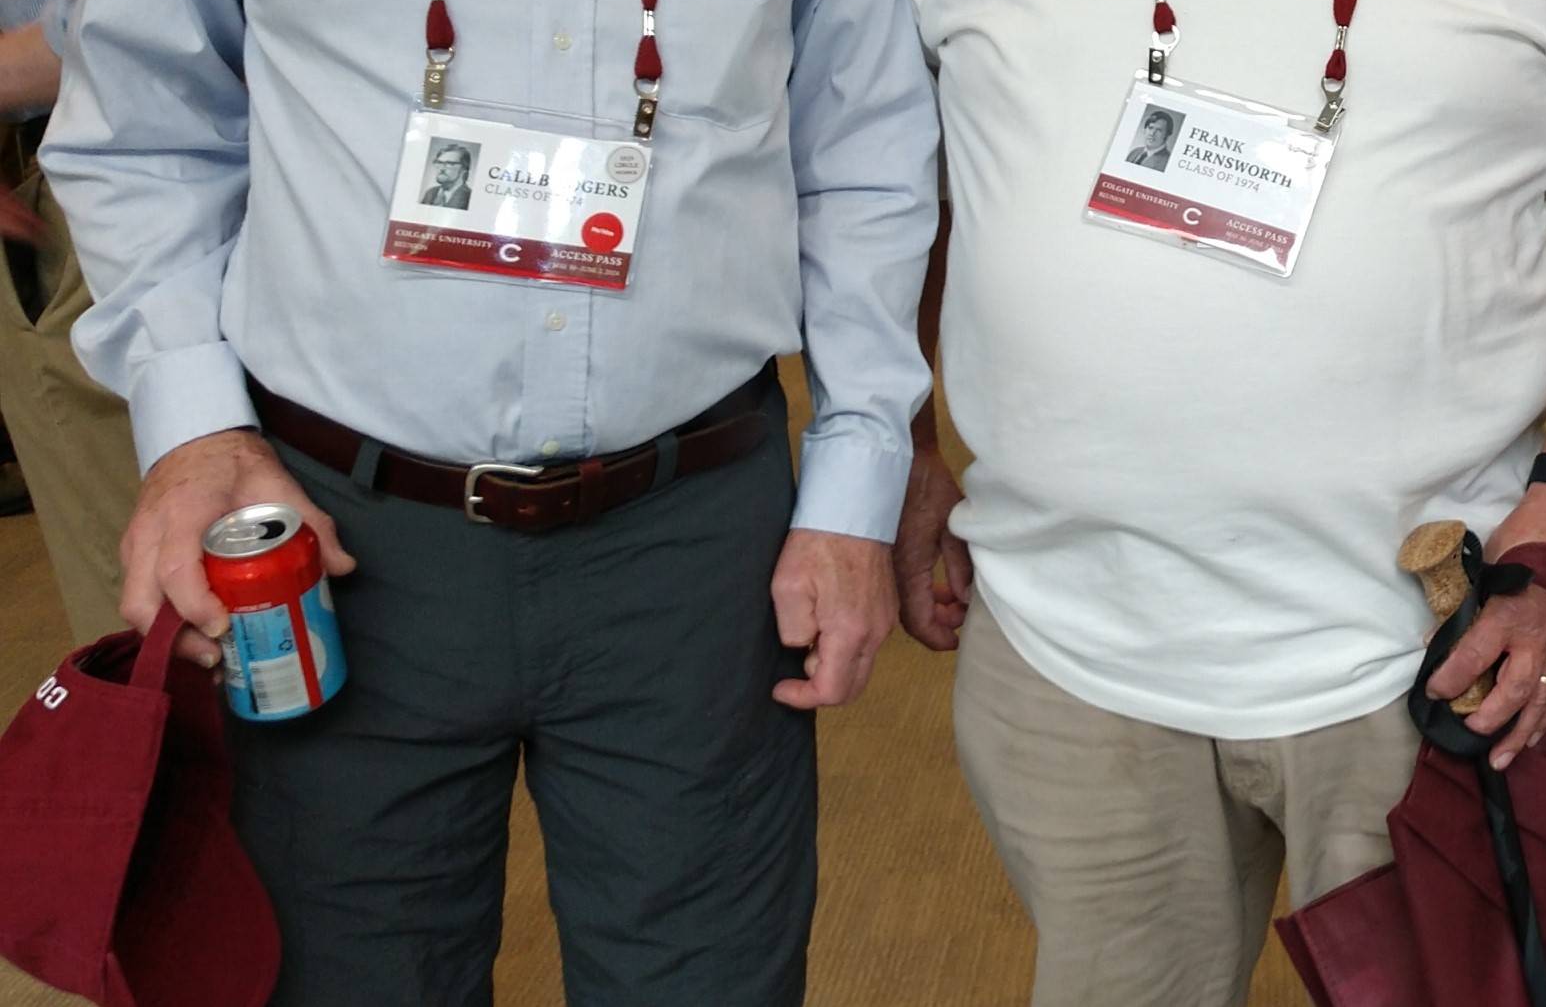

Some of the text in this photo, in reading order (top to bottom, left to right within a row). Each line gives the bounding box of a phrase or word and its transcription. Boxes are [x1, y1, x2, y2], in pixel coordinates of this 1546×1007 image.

[1188, 127, 1246, 154] FRANK
[1177, 159, 1261, 193] CLASS OF 1974
[1183, 144, 1293, 188] FARNSWORTH
[484, 183, 530, 199] CLASS
[1102, 181, 1179, 209] COLGATE UNIVERSITY
[1182, 207, 1202, 225] C
[395, 229, 493, 249] COLGATE UNIVERSITY
[1225, 219, 1263, 236] ACCESS
[1264, 231, 1289, 244] PASS
[499, 243, 522, 262] C
[551, 249, 623, 266] ACCESS PASS
